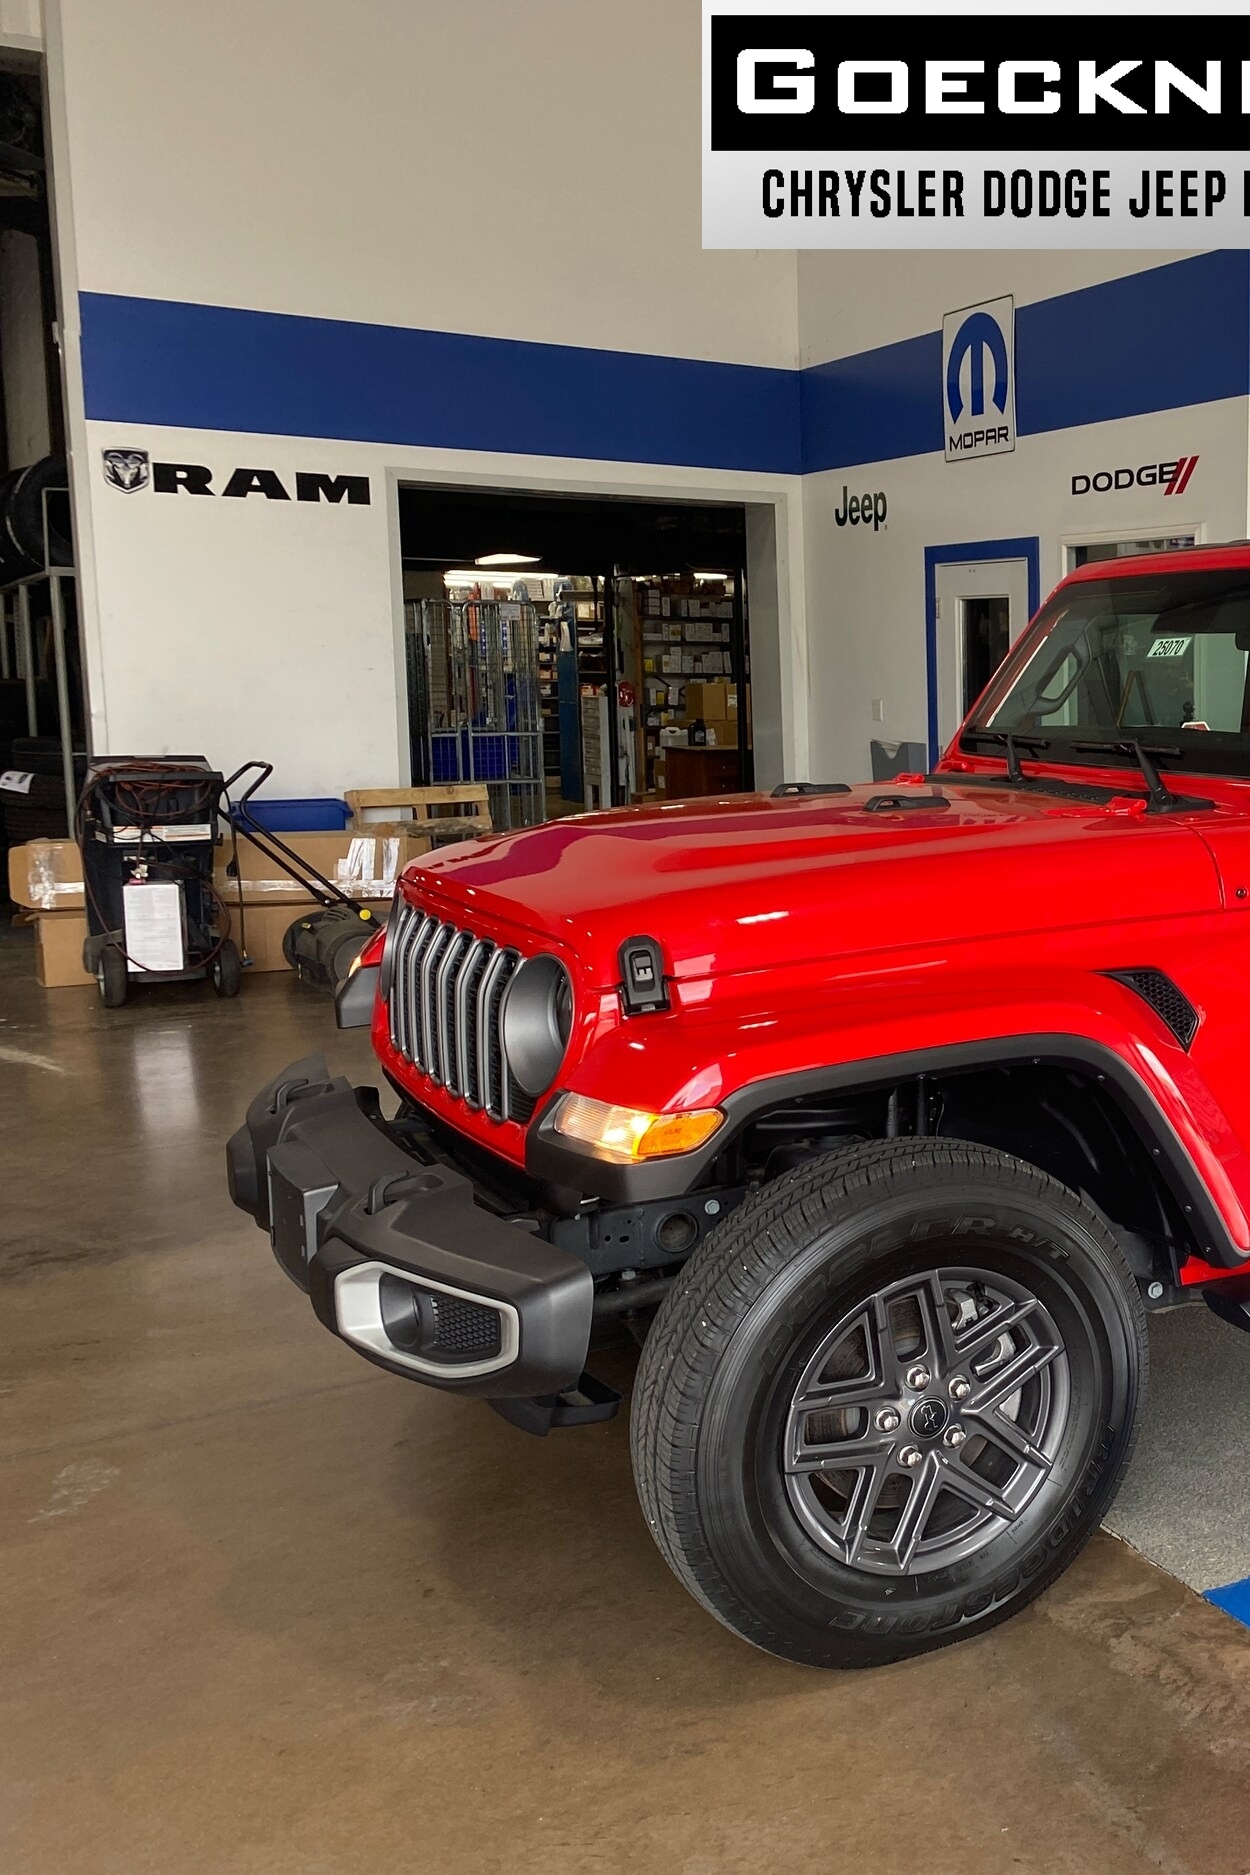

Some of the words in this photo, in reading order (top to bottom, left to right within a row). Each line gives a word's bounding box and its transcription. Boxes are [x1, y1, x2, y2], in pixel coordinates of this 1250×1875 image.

[949, 424, 1010, 452] MOPAR
[152, 462, 371, 506] RAM
[1071, 460, 1181, 496] DODGE
[834, 485, 888, 532] Jeep
[1152, 639, 1185, 656] 25070
